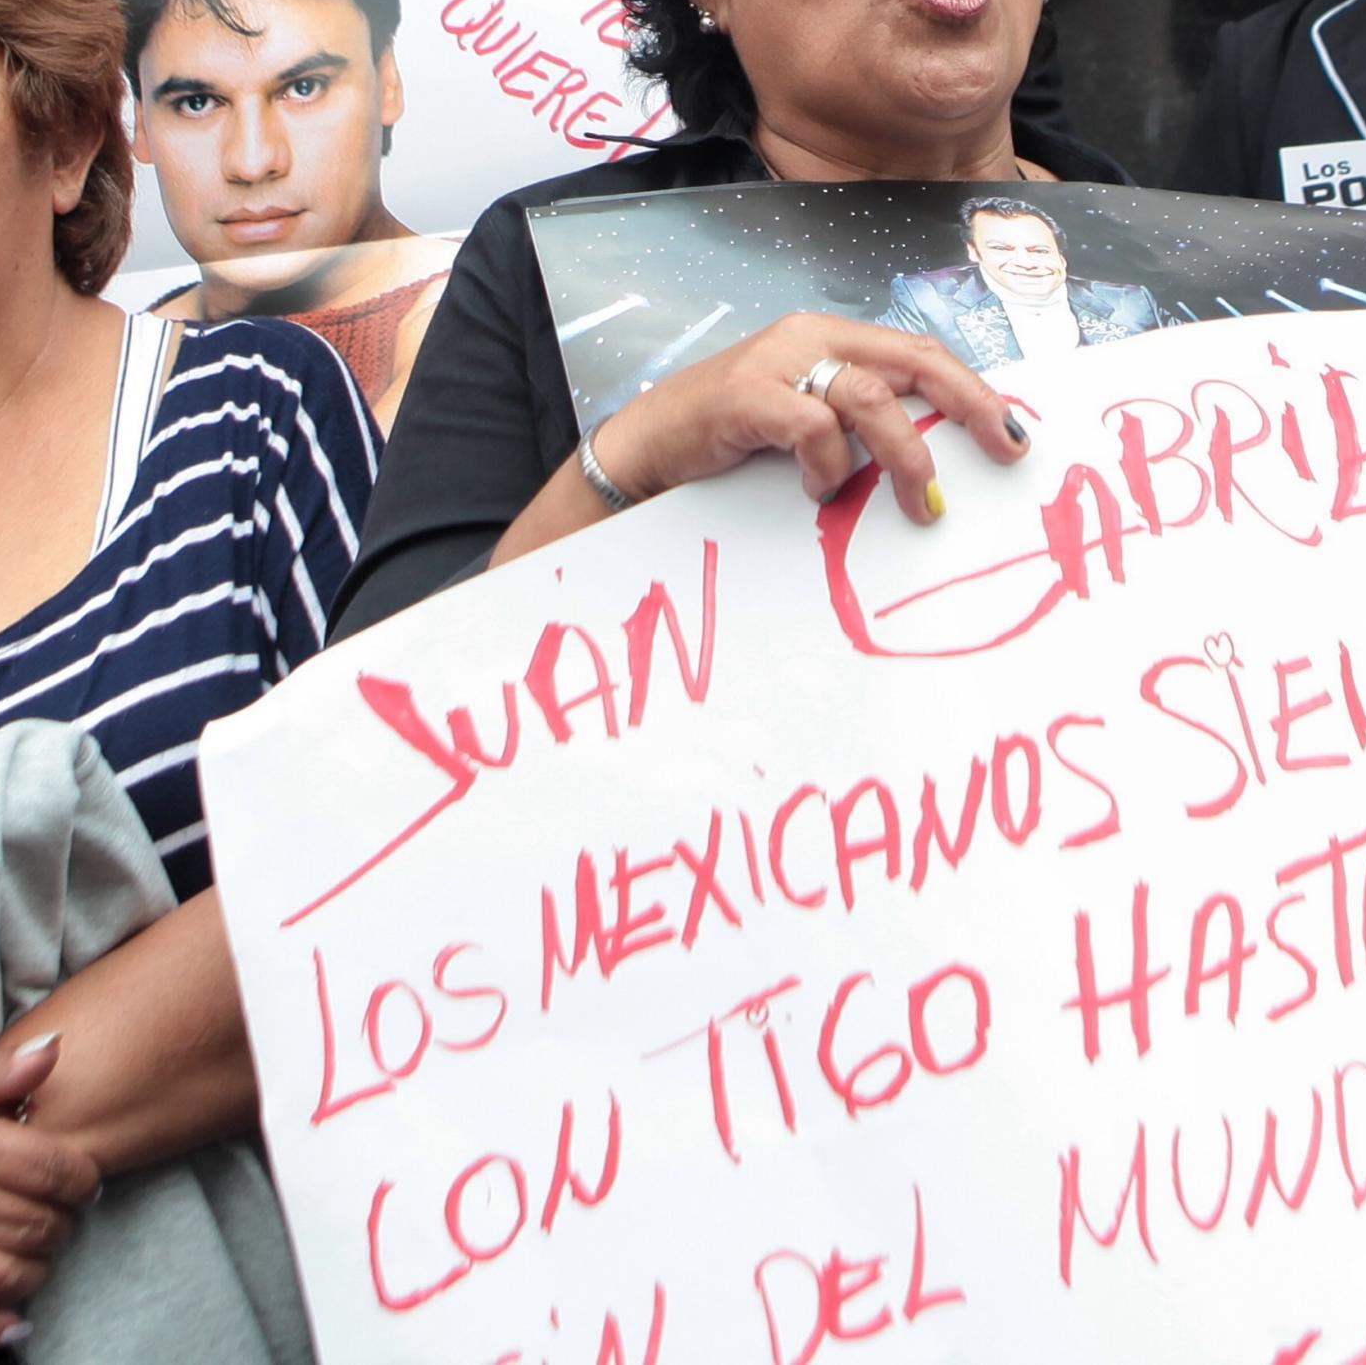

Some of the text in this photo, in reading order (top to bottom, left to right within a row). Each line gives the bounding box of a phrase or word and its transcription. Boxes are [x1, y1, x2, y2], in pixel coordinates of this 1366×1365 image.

[1302, 160, 1352, 181] Los
[310, 940, 508, 1127] LOS
[366, 1090, 623, 1316] CON
[753, 1183, 967, 1365] DEL
